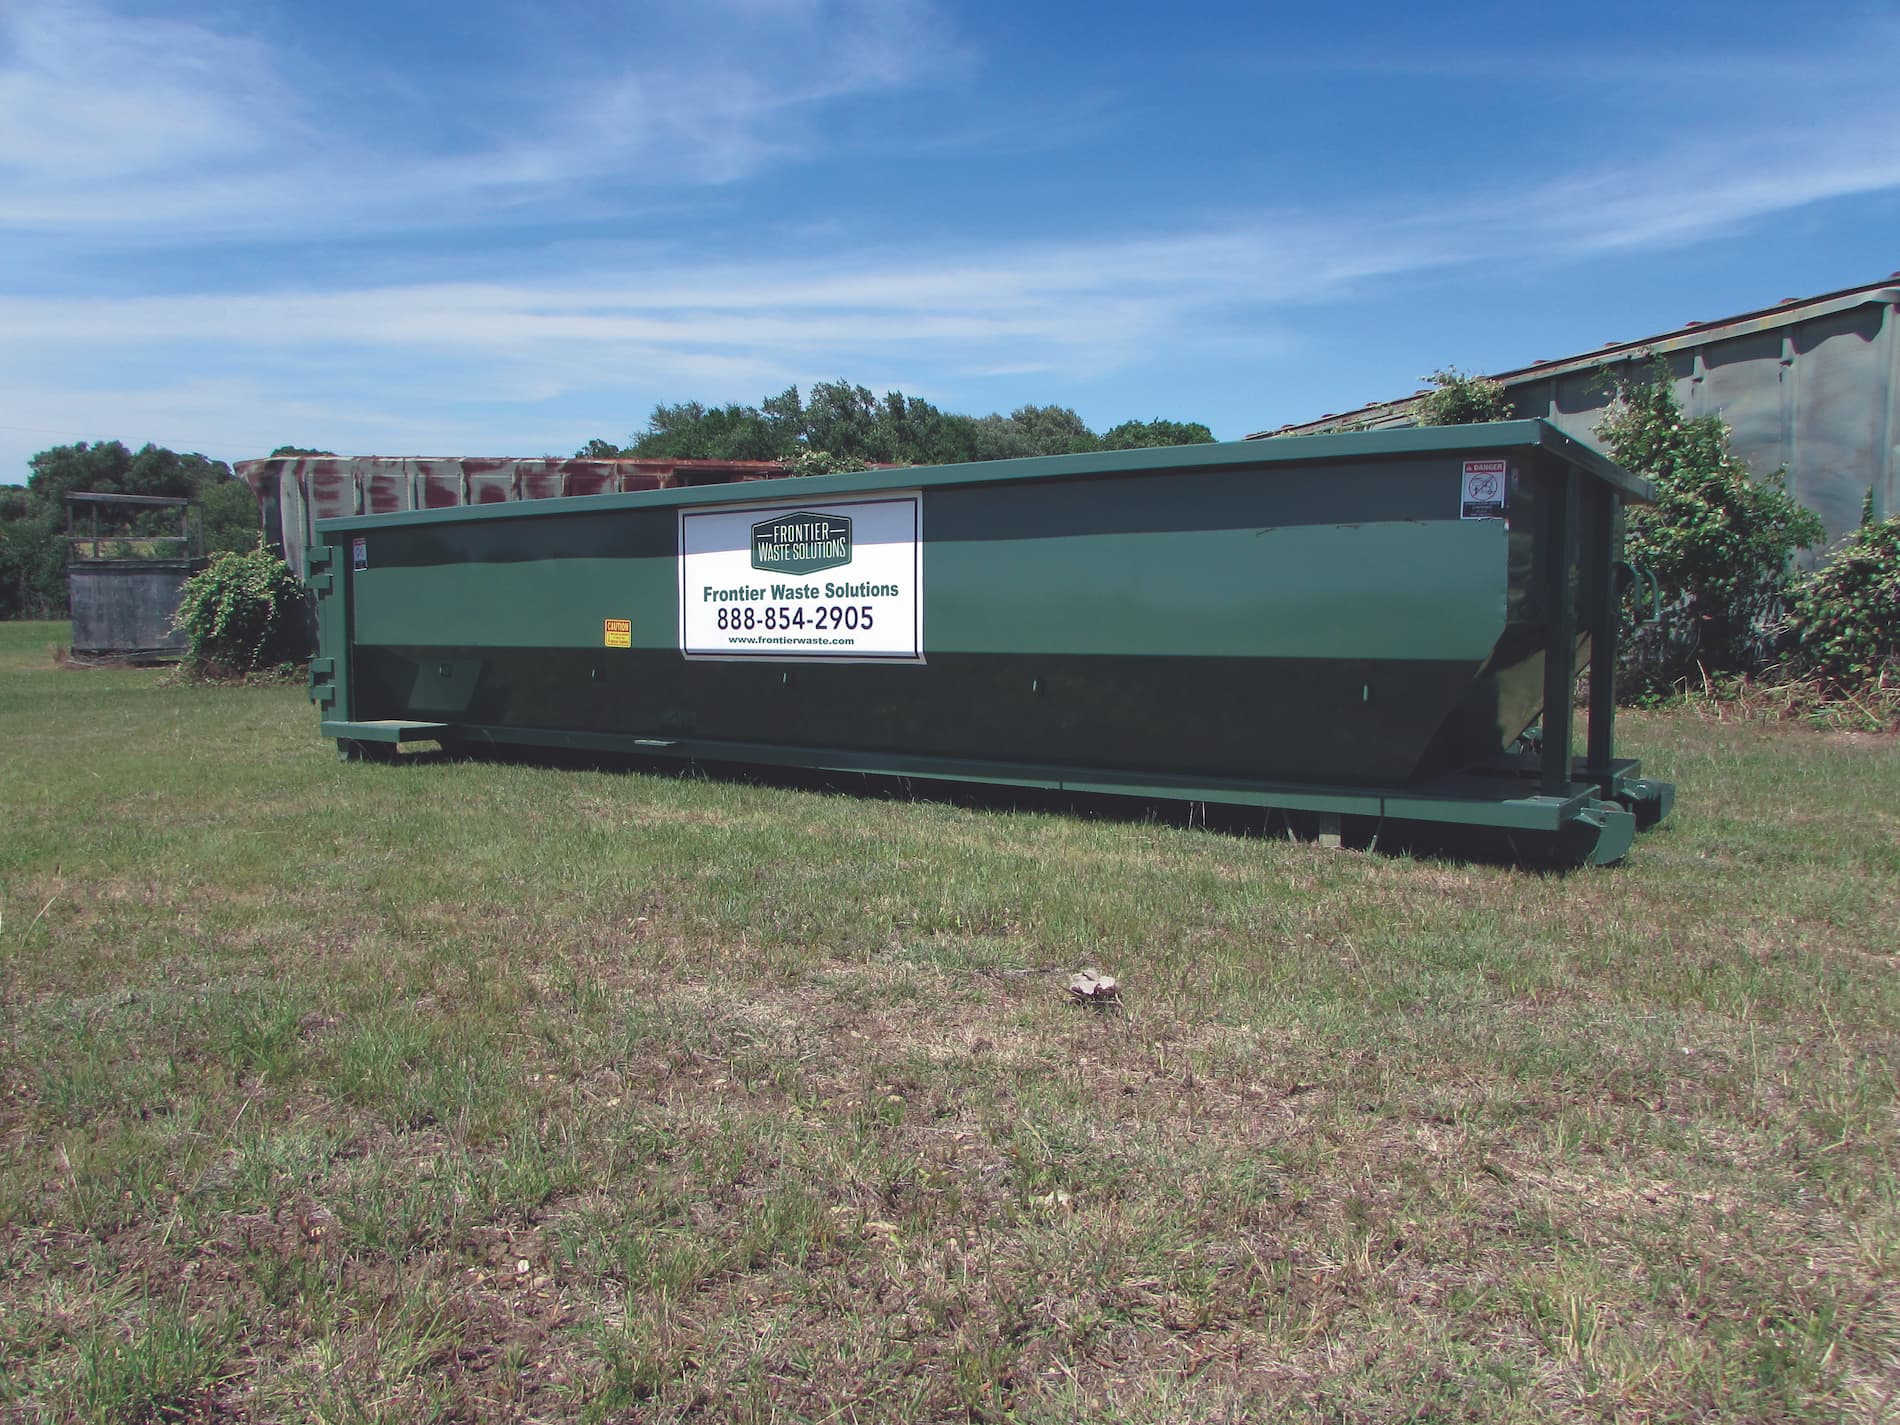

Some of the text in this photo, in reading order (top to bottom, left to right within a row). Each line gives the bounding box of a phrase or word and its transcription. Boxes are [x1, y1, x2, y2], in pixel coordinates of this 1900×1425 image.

[1473, 463, 1502, 471] DANGER
[773, 522, 829, 543] FRONTIER
[758, 537, 846, 562] WASTE SOLUTIONS
[703, 581, 899, 602] Frontier Waste Solutions
[717, 606, 874, 630] 888-854-2905
[728, 635, 855, 645] www.frontierwaste.com
